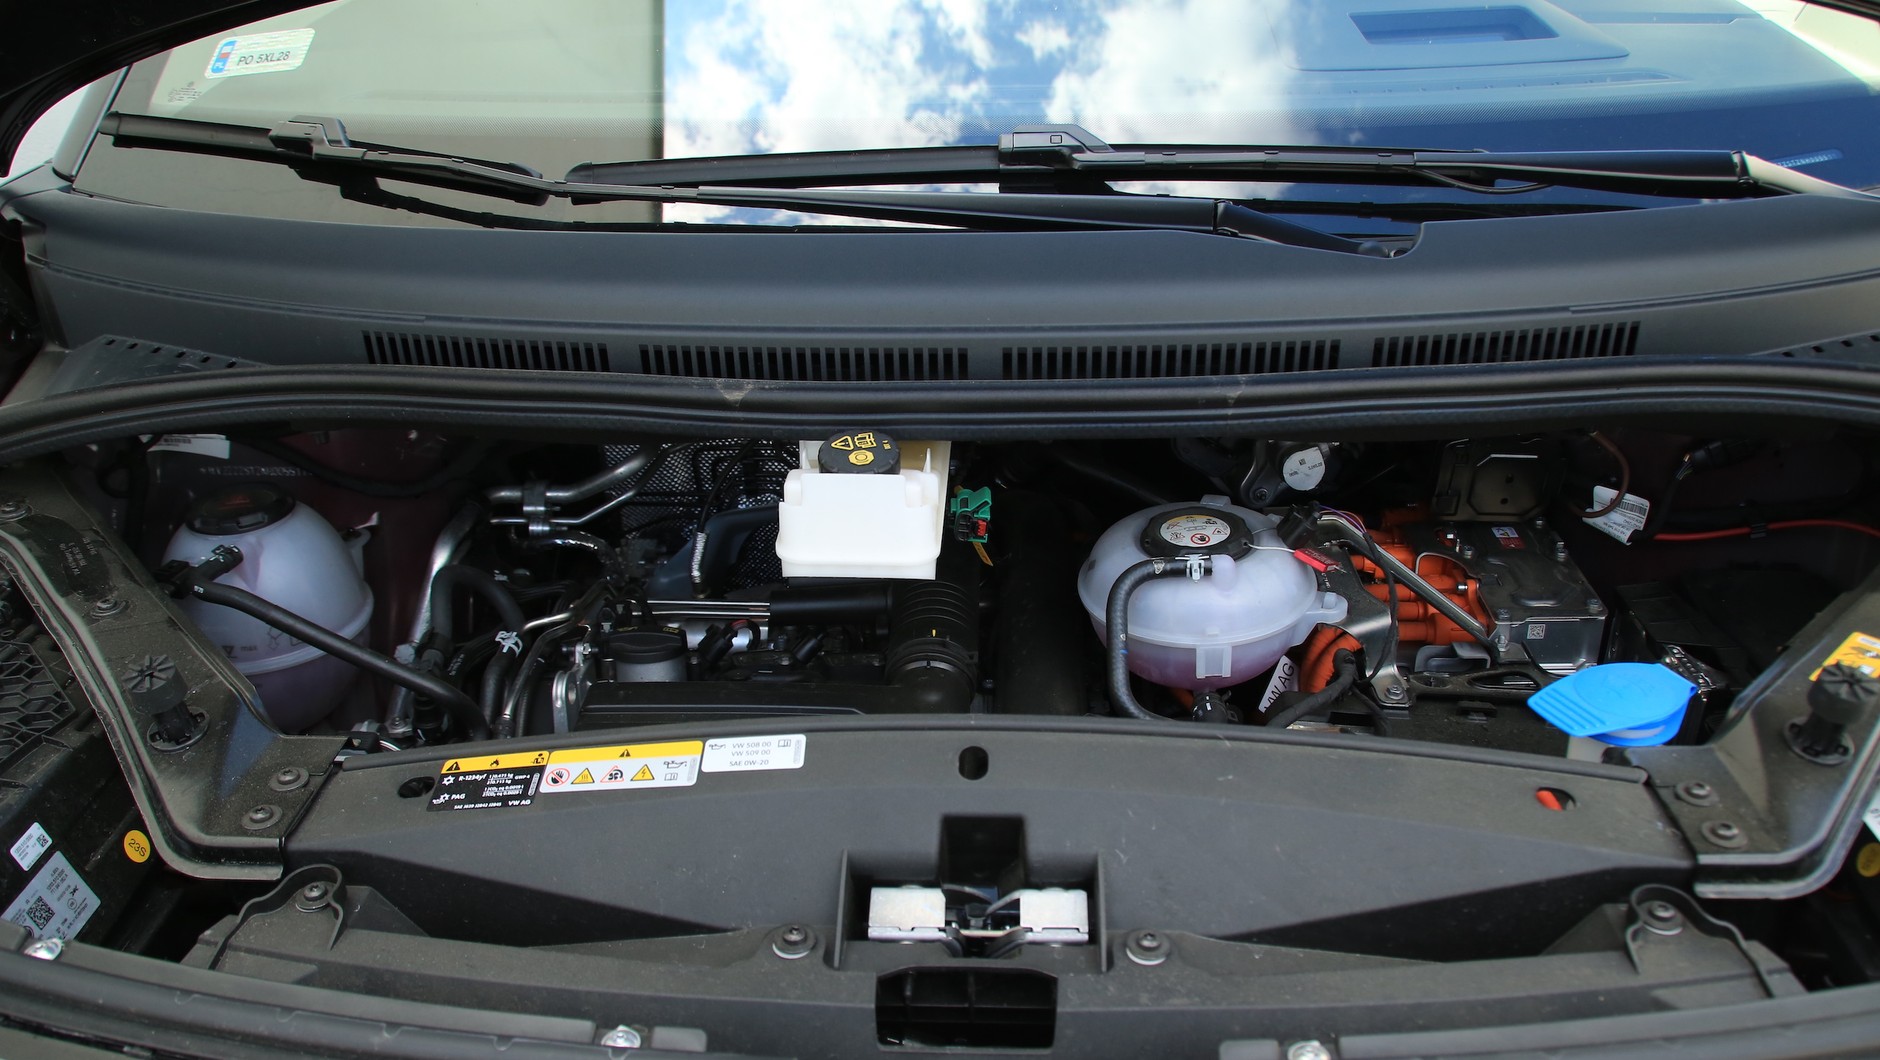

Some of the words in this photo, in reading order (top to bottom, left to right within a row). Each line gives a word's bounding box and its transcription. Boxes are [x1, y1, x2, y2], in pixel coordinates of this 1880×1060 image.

[237, 55, 254, 66] PO
[256, 51, 291, 64] 5XL28
[1278, 663, 1295, 689] AG
[128, 838, 147, 857] 23S
